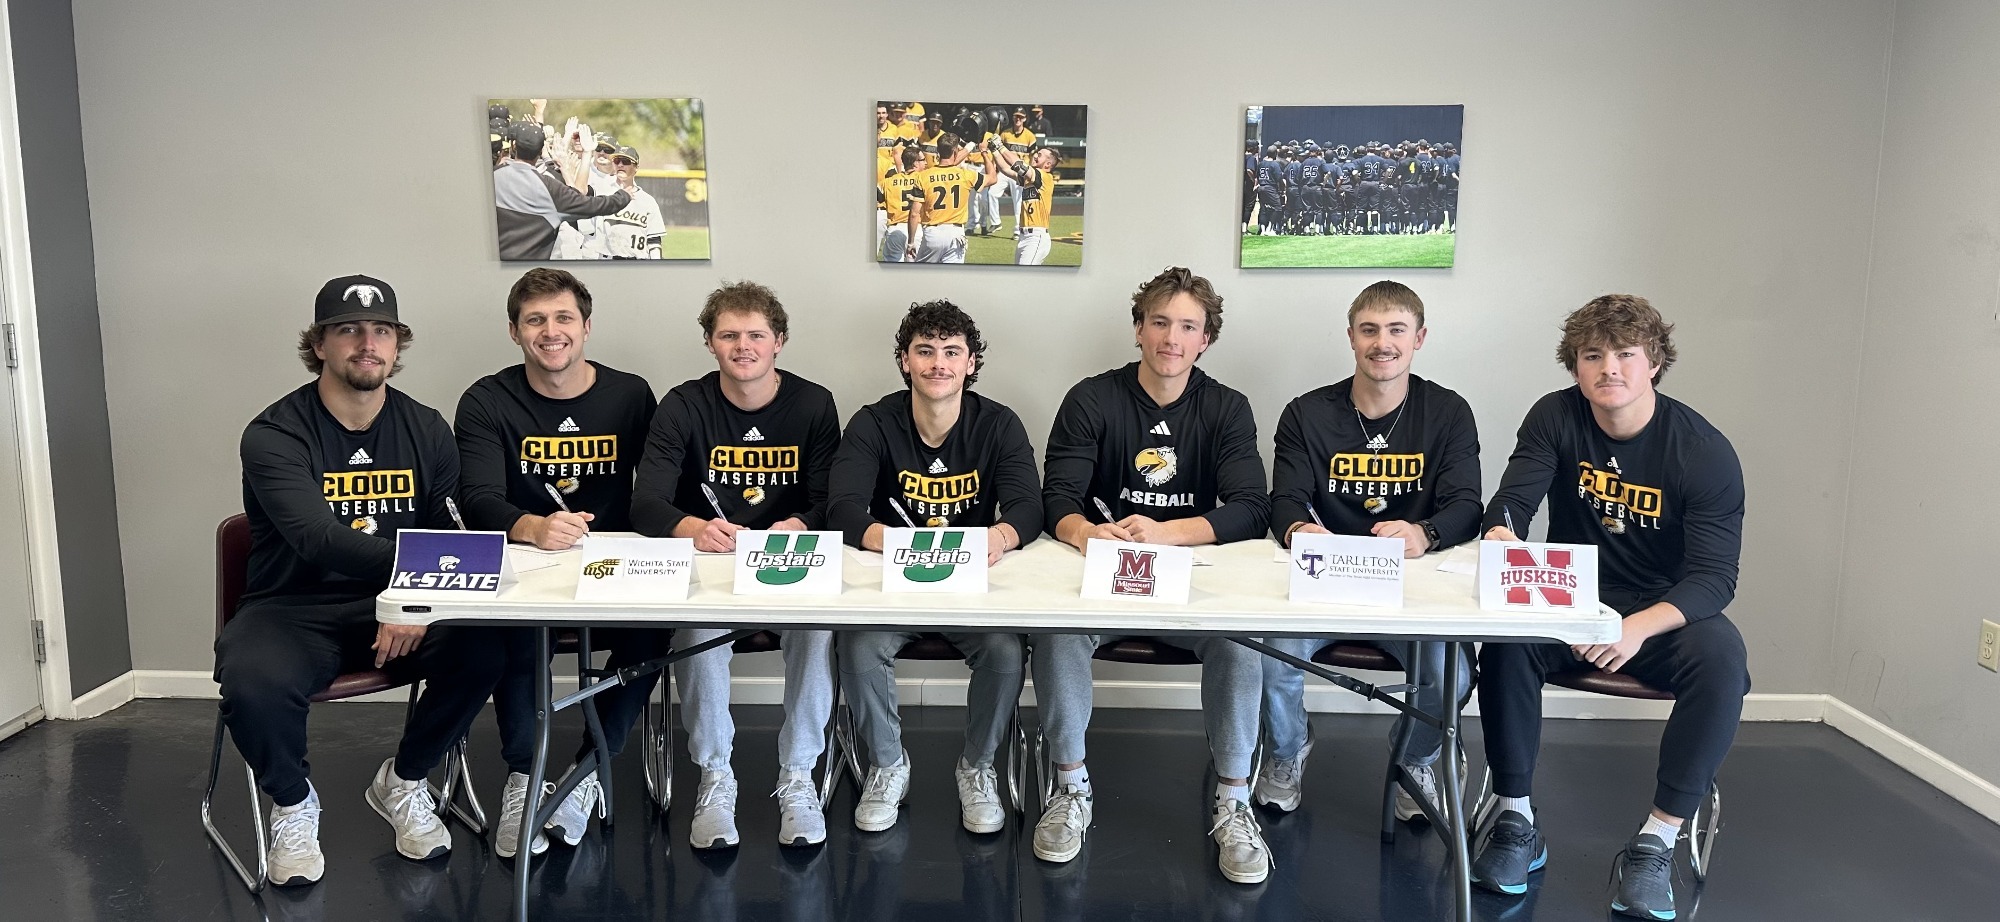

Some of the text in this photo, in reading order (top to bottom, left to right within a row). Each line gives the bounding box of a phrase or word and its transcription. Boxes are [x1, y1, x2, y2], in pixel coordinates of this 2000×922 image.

[929, 173, 961, 182] BIRDS
[933, 185, 960, 210] 21
[1028, 203, 1034, 214] 6
[631, 234, 645, 250] 18
[524, 439, 614, 459] CLOUD
[713, 449, 796, 468] CLOUD
[1333, 457, 1421, 477] CLOUD
[520, 461, 617, 477] BASEBALL
[708, 469, 798, 485] BASEBALL
[322, 474, 411, 497] CLOUD
[900, 473, 978, 500] CLOUD
[1328, 479, 1423, 496] BASEBALL
[328, 498, 415, 515] SEBALL
[1578, 485, 1661, 530] BSEBALL
[747, 551, 825, 568] Upstate
[894, 548, 970, 566] Upstate
[1116, 550, 1157, 580] M
[1302, 553, 1323, 576] T
[1329, 554, 1400, 568] TARLETON
[393, 571, 500, 589] K-STATE
[1500, 569, 1577, 588] HUSKERS
